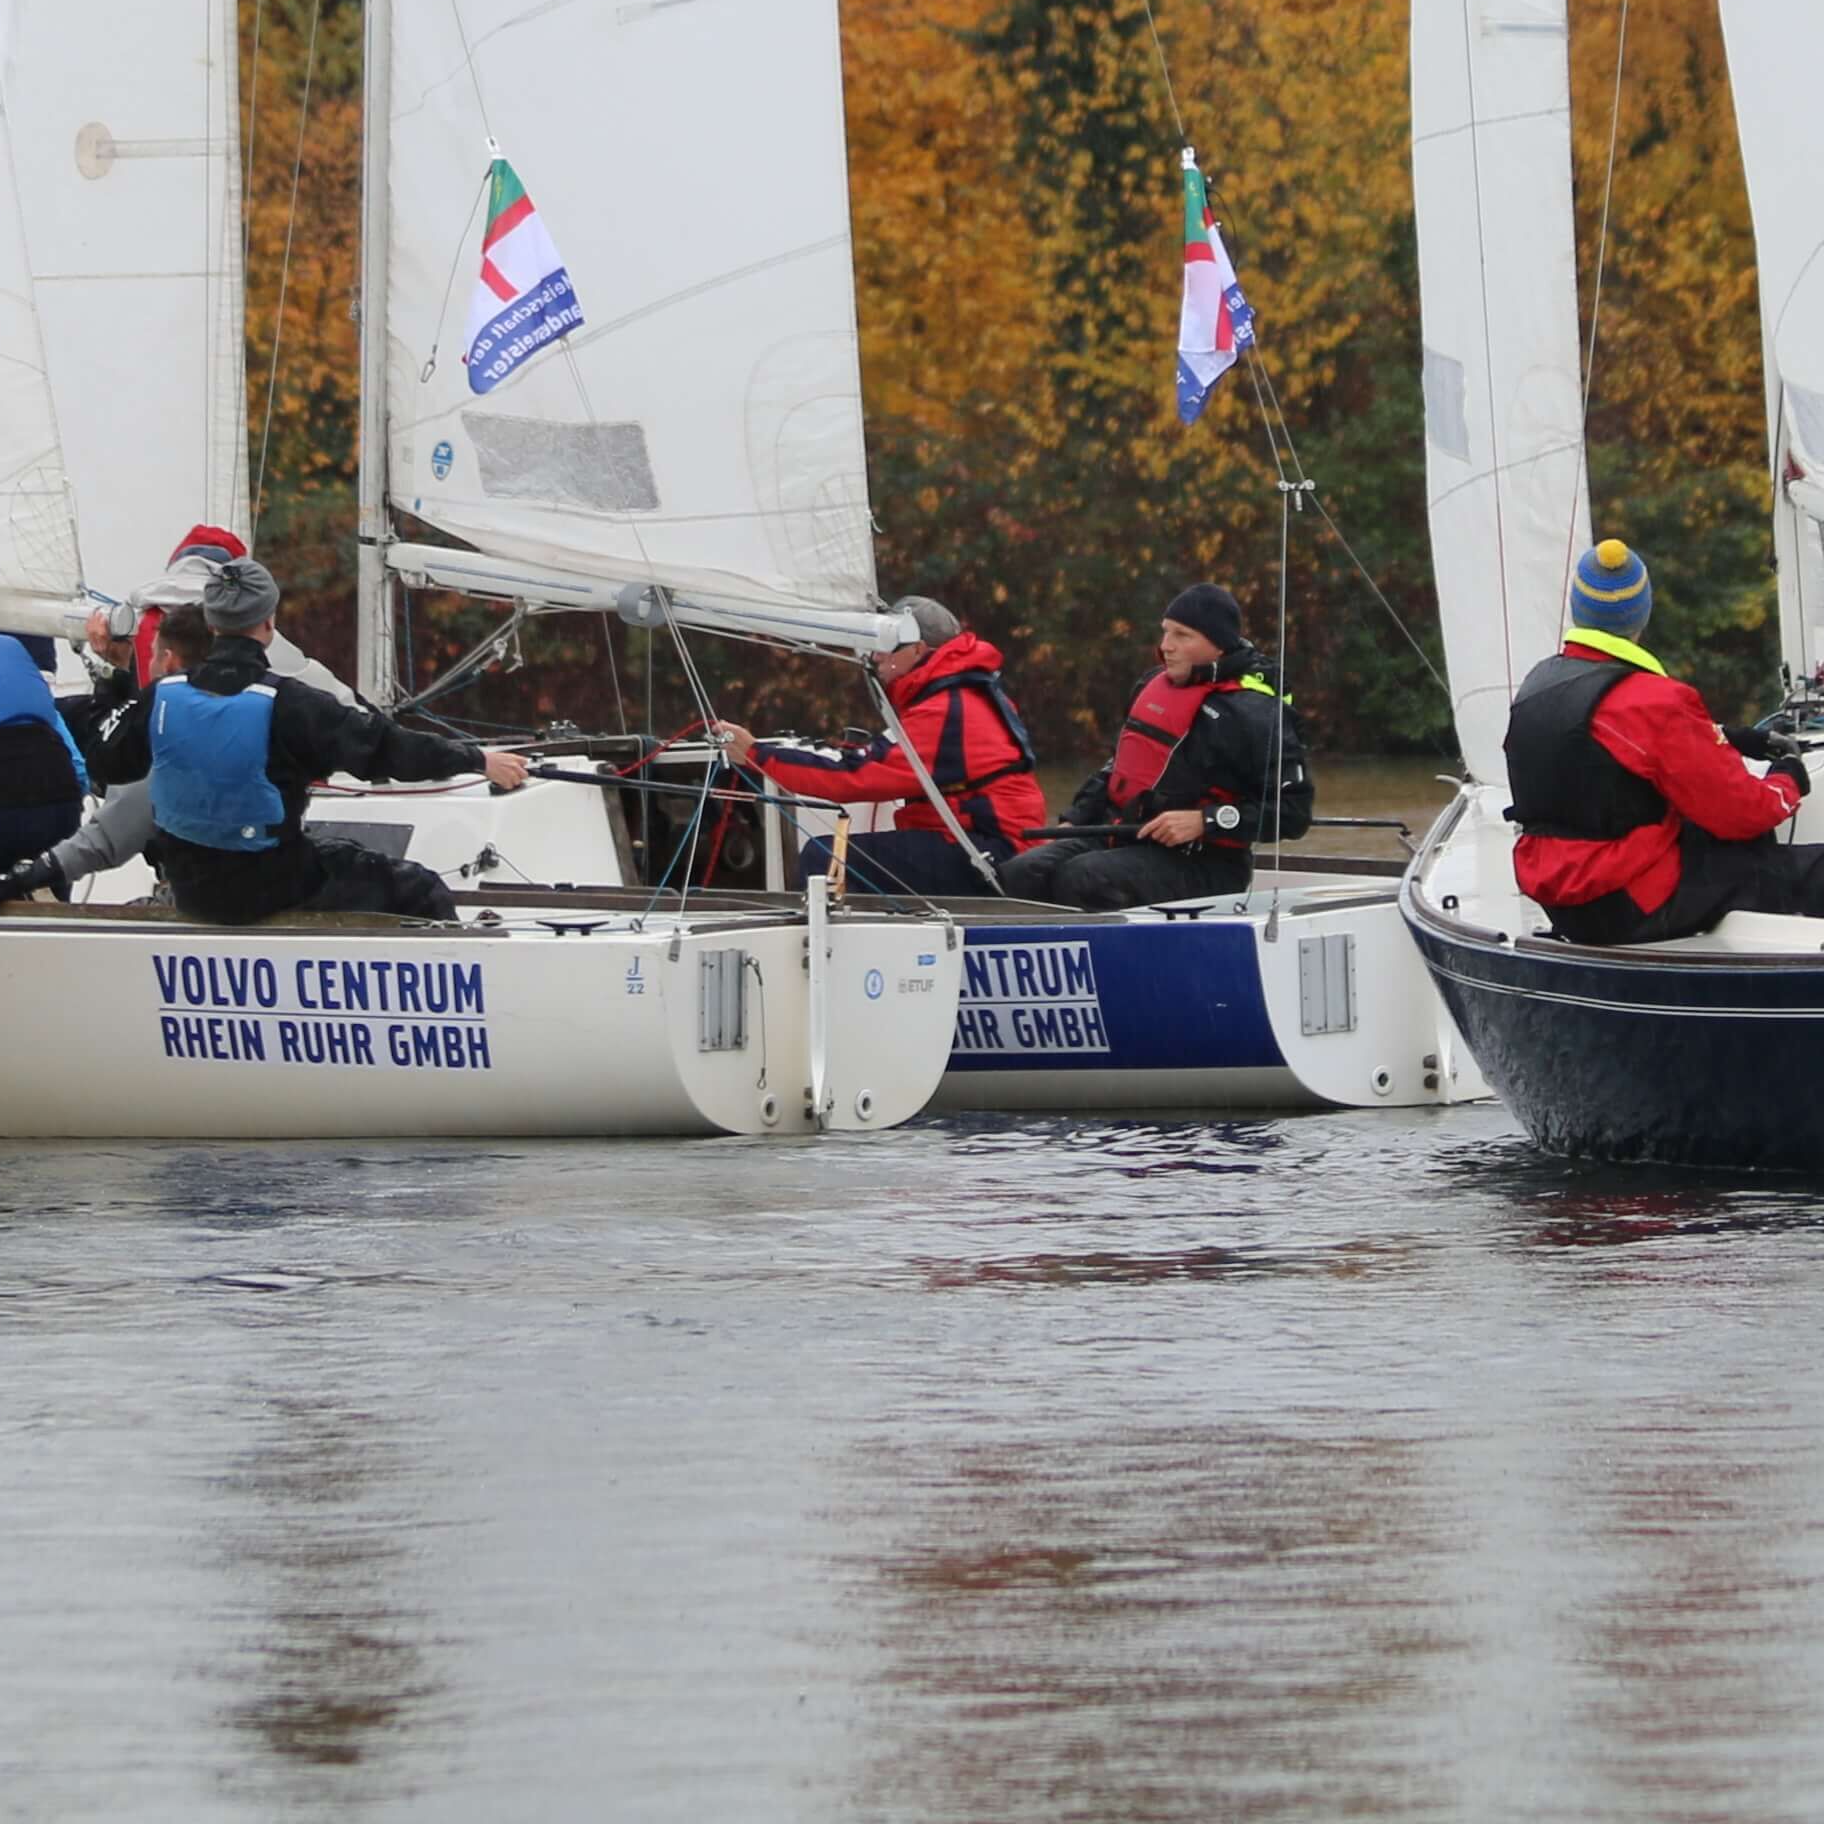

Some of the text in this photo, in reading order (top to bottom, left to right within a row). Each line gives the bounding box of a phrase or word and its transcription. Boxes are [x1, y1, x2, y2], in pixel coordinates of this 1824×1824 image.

[152, 955, 485, 1014] VOLVO CENTRUM
[627, 983, 644, 994] 22
[959, 947, 1097, 999] NTRUM
[160, 1016, 493, 1069] RHEIN RUHR GMBH
[1011, 1007, 1109, 1049] GMBH
